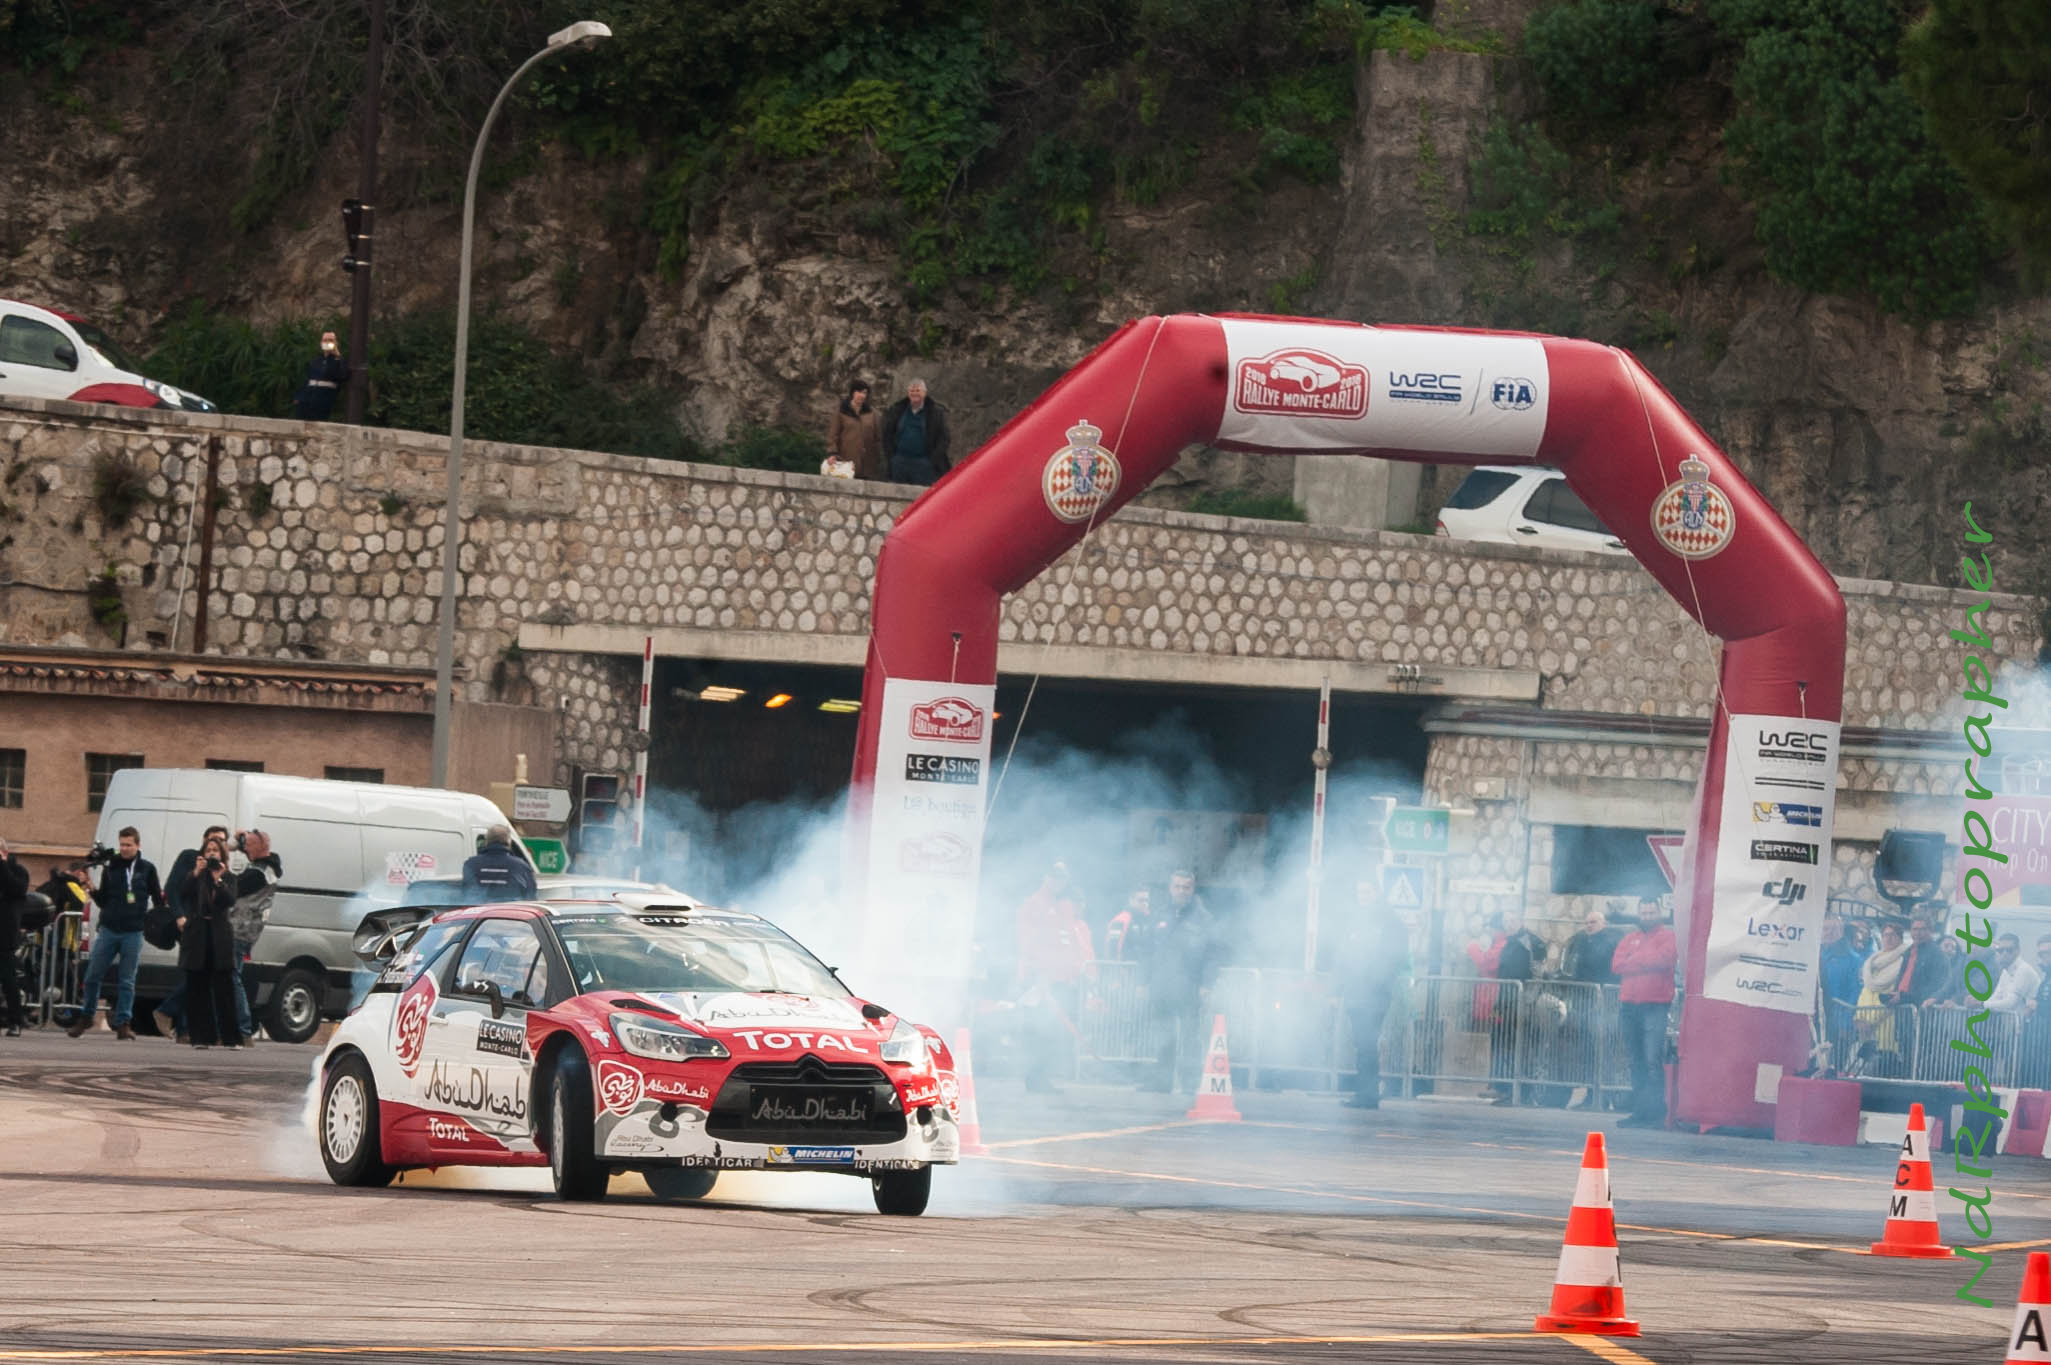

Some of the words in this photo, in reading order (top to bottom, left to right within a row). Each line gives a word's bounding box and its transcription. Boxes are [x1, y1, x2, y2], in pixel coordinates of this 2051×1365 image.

[1390, 371, 1462, 391] WRC
[1242, 379, 1280, 406] RALLYE
[1282, 383, 1362, 411] MONTE-CARLO
[1759, 730, 1828, 752] WRC
[908, 757, 925, 770] LE
[927, 757, 979, 774] CASINO
[1991, 806, 2051, 847] CITY
[1755, 843, 1808, 855] CERTINA
[1747, 916, 1805, 941] Lexar
[480, 1022, 490, 1038] LE
[490, 1024, 523, 1045] CASINO
[733, 1030, 869, 1054] TOTAL
[424, 1058, 469, 1109] Abu
[646, 1079, 673, 1093] Abu
[673, 1082, 709, 1099] Dhabi
[752, 1098, 800, 1120] Abu
[801, 1098, 866, 1120] Dhabi
[428, 1117, 471, 1143] TOTAL
[794, 1149, 853, 1158] MICHELIN
